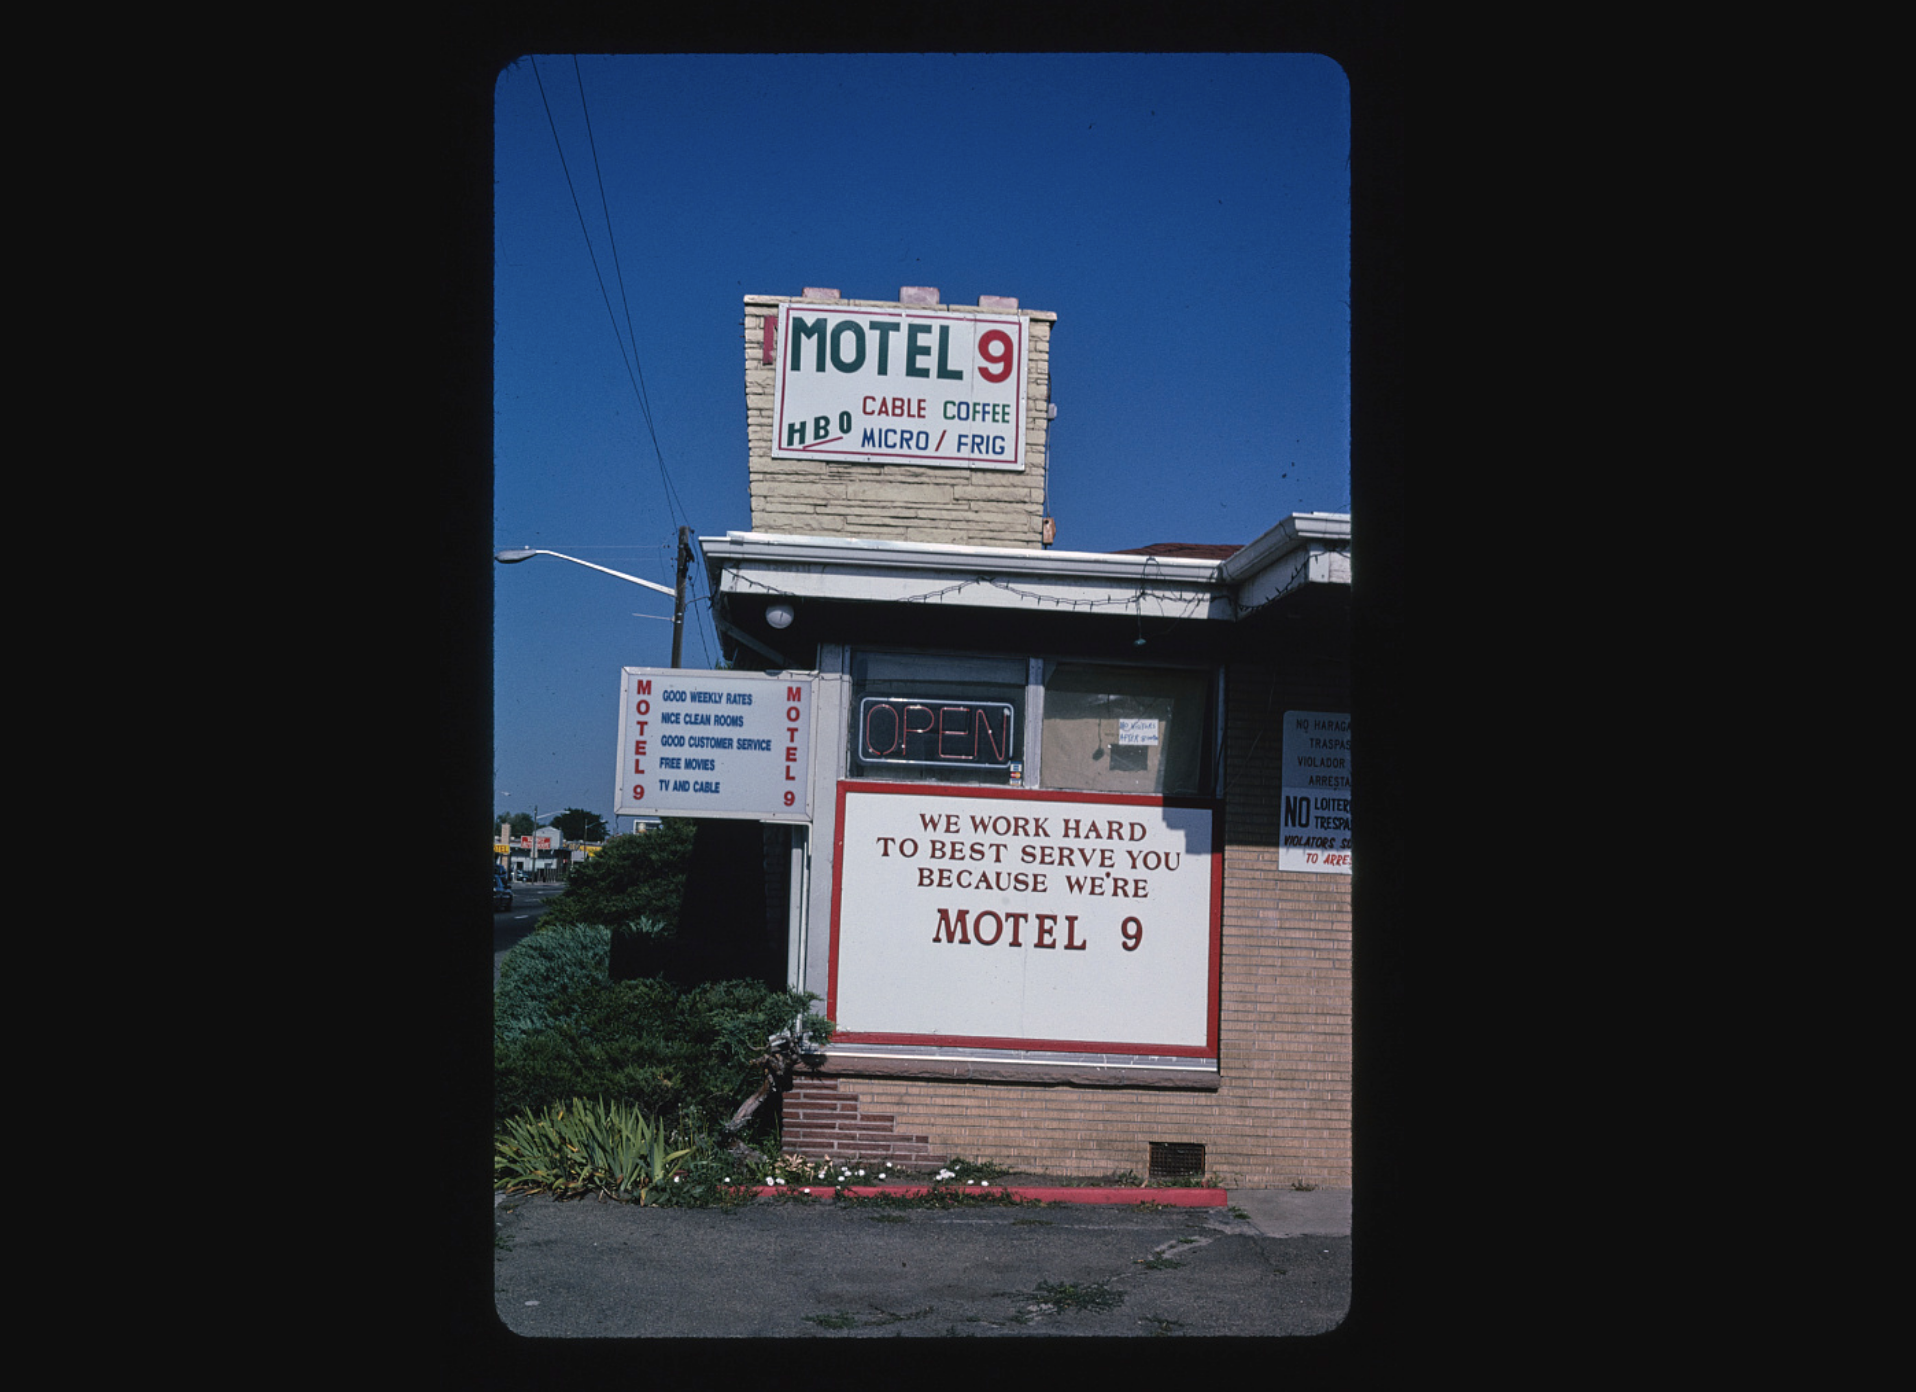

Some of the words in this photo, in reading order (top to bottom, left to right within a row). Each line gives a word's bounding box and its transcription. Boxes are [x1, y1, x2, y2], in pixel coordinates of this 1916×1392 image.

[790, 316, 964, 380] MOTEL
[977, 329, 1014, 383] 9
[862, 396, 926, 418] CABLE
[943, 400, 1010, 424] COFFEE
[786, 410, 852, 446] HBO
[861, 428, 929, 451] MICRO
[956, 434, 1006, 455] FRIG
[662, 690, 687, 703] GOOD
[690, 691, 724, 704] WEEKLY
[726, 692, 753, 706] RATES
[634, 680, 652, 774] MOTEL
[661, 712, 681, 724] NICE
[683, 713, 711, 726] CLEAN
[714, 714, 744, 727] ROOMS
[866, 703, 1008, 760] OPEN
[1296, 719, 1309, 731] NO
[661, 735, 685, 747] GOOD
[688, 736, 733, 750] CUSTOMER
[736, 738, 772, 751] SERVICE
[785, 686, 802, 781] MOTEL
[659, 757, 681, 770] FREE
[684, 758, 715, 771] MOVIES
[1297, 756, 1346, 769] VIOLADOR
[633, 785, 645, 800] 9
[659, 779, 670, 791] TV
[672, 780, 690, 792] AND
[693, 781, 720, 794] CABLE
[783, 791, 795, 807] 9
[1284, 796, 1311, 828] NO
[919, 813, 961, 834] WE
[969, 814, 1051, 838] WORK
[1062, 818, 1148, 842] HARD
[876, 837, 919, 858] TO
[930, 840, 1008, 864] BEST
[1021, 844, 1116, 869] SERVE
[1126, 850, 1181, 872] YOU
[1284, 835, 1336, 849] VIOLATORS
[1306, 853, 1318, 864] TO
[917, 868, 1048, 893] BECAUSE
[1066, 872, 1149, 899] WE'RE
[932, 908, 1087, 950] MOTEL
[1120, 916, 1144, 951] 9
